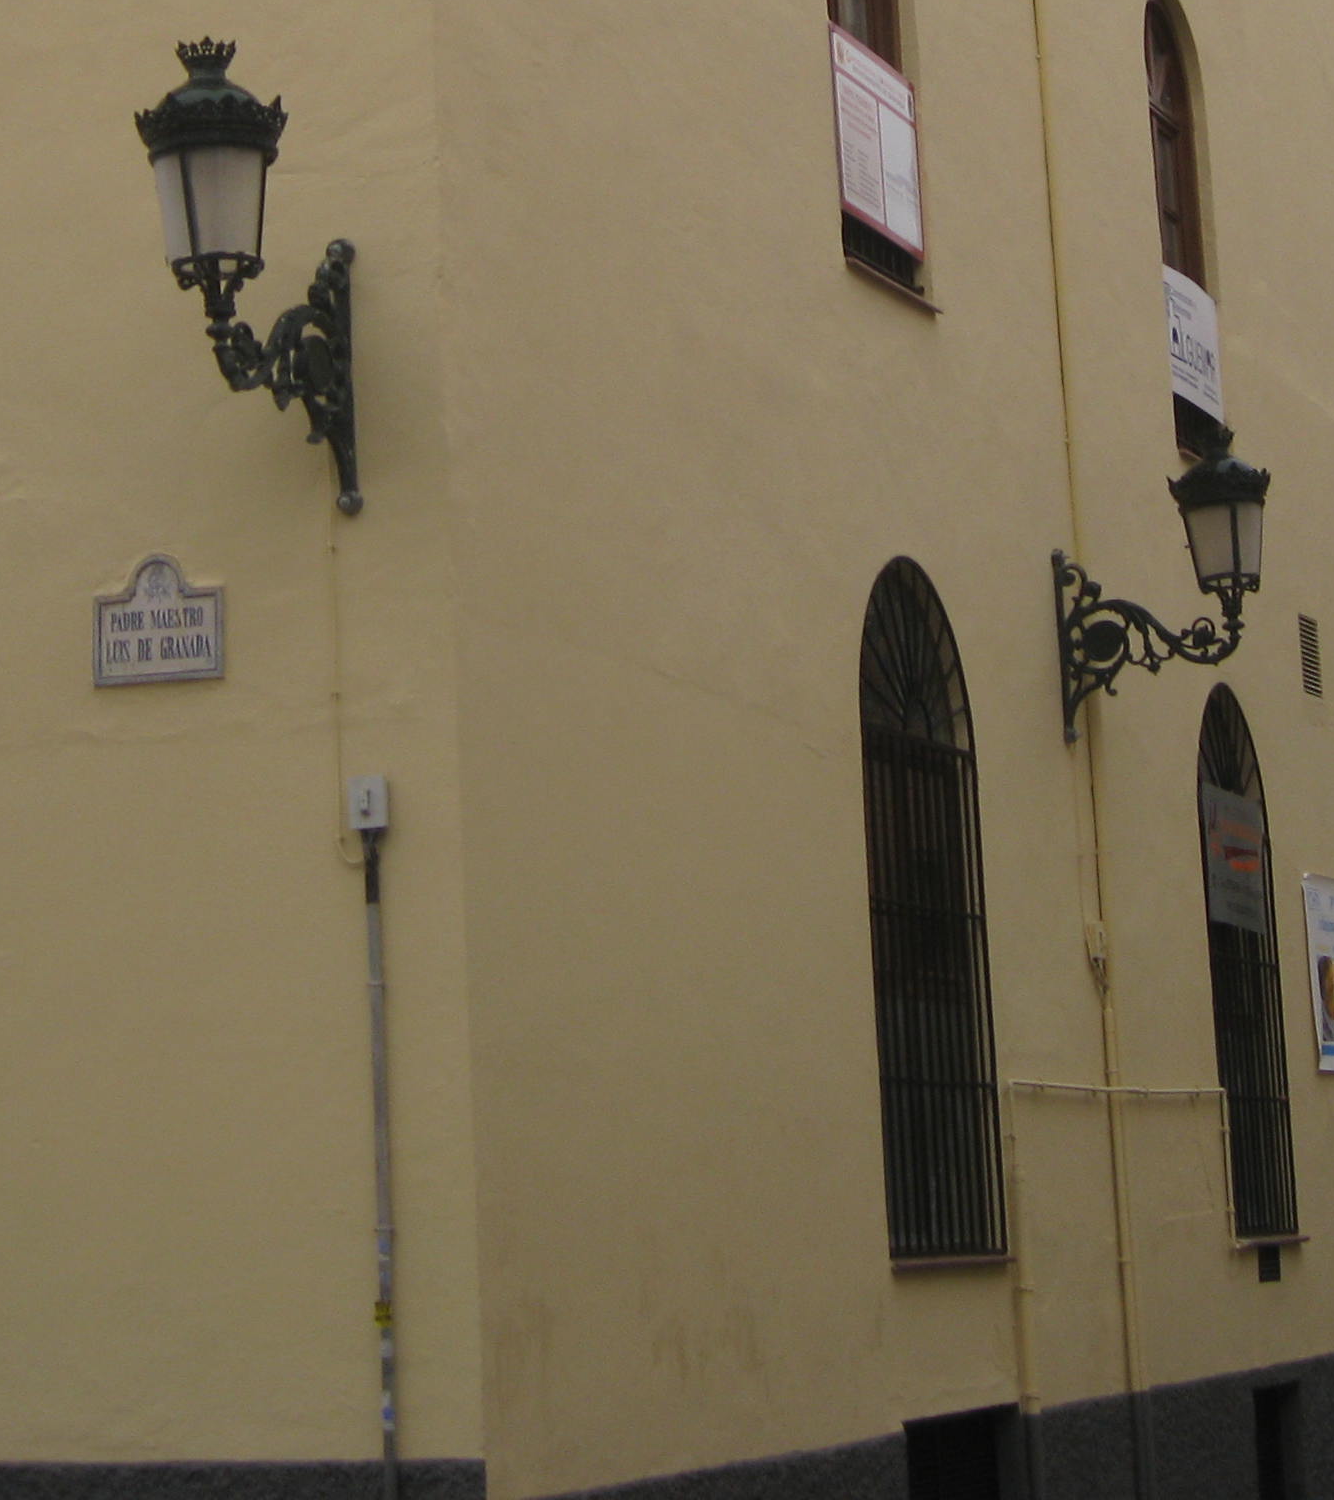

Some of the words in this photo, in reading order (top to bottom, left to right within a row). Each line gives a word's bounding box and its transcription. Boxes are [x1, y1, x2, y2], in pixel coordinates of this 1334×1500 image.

[110, 611, 144, 633] PADRE
[150, 606, 204, 629] MAESTRO
[105, 640, 131, 664] LUIS
[137, 637, 153, 662] DE
[160, 633, 212, 660] GRANADA
